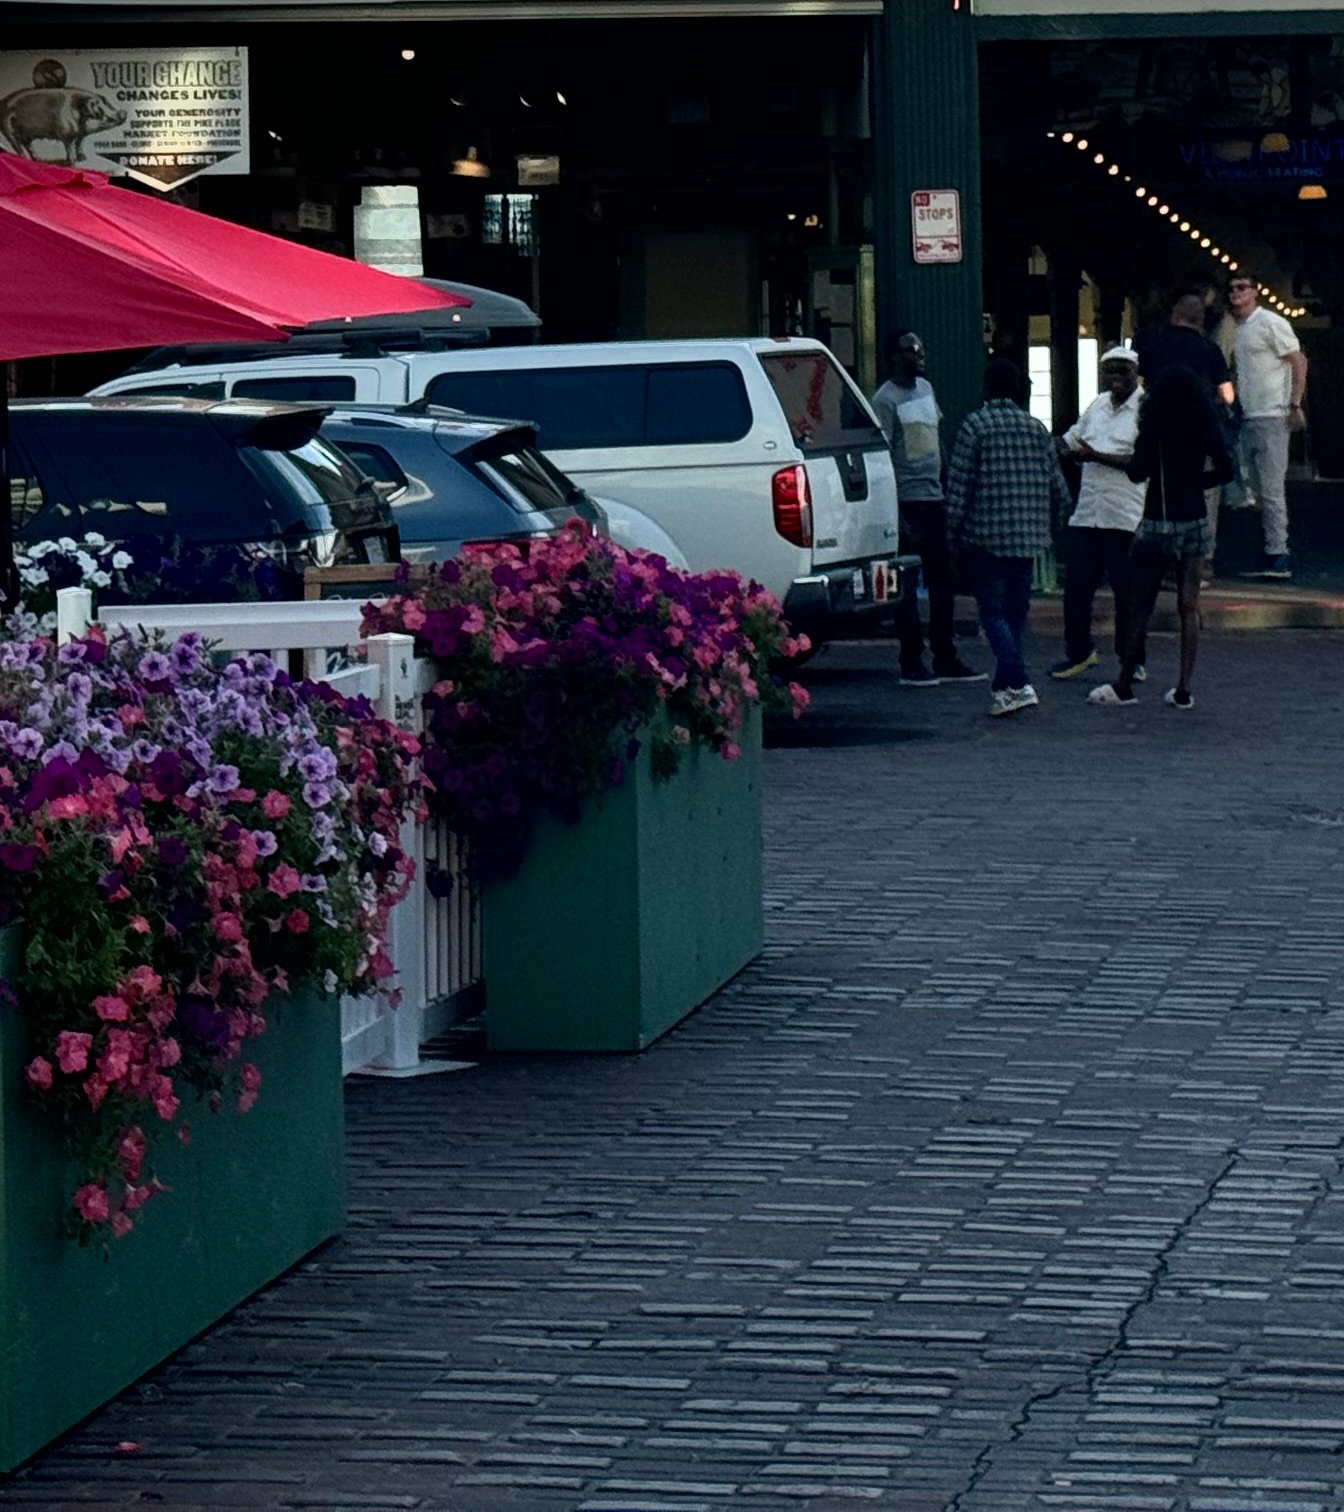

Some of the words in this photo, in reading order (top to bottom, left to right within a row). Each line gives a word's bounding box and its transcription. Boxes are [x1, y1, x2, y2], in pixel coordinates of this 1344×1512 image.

[90, 61, 151, 88] YOUR
[154, 60, 242, 87] CHANGE
[116, 89, 189, 101] CHANGES
[194, 89, 242, 100] LIVES!
[135, 109, 165, 117] YOUR
[169, 108, 241, 117] GENEROSITY
[120, 155, 175, 166] DONATE
[918, 207, 954, 221] STOPS
